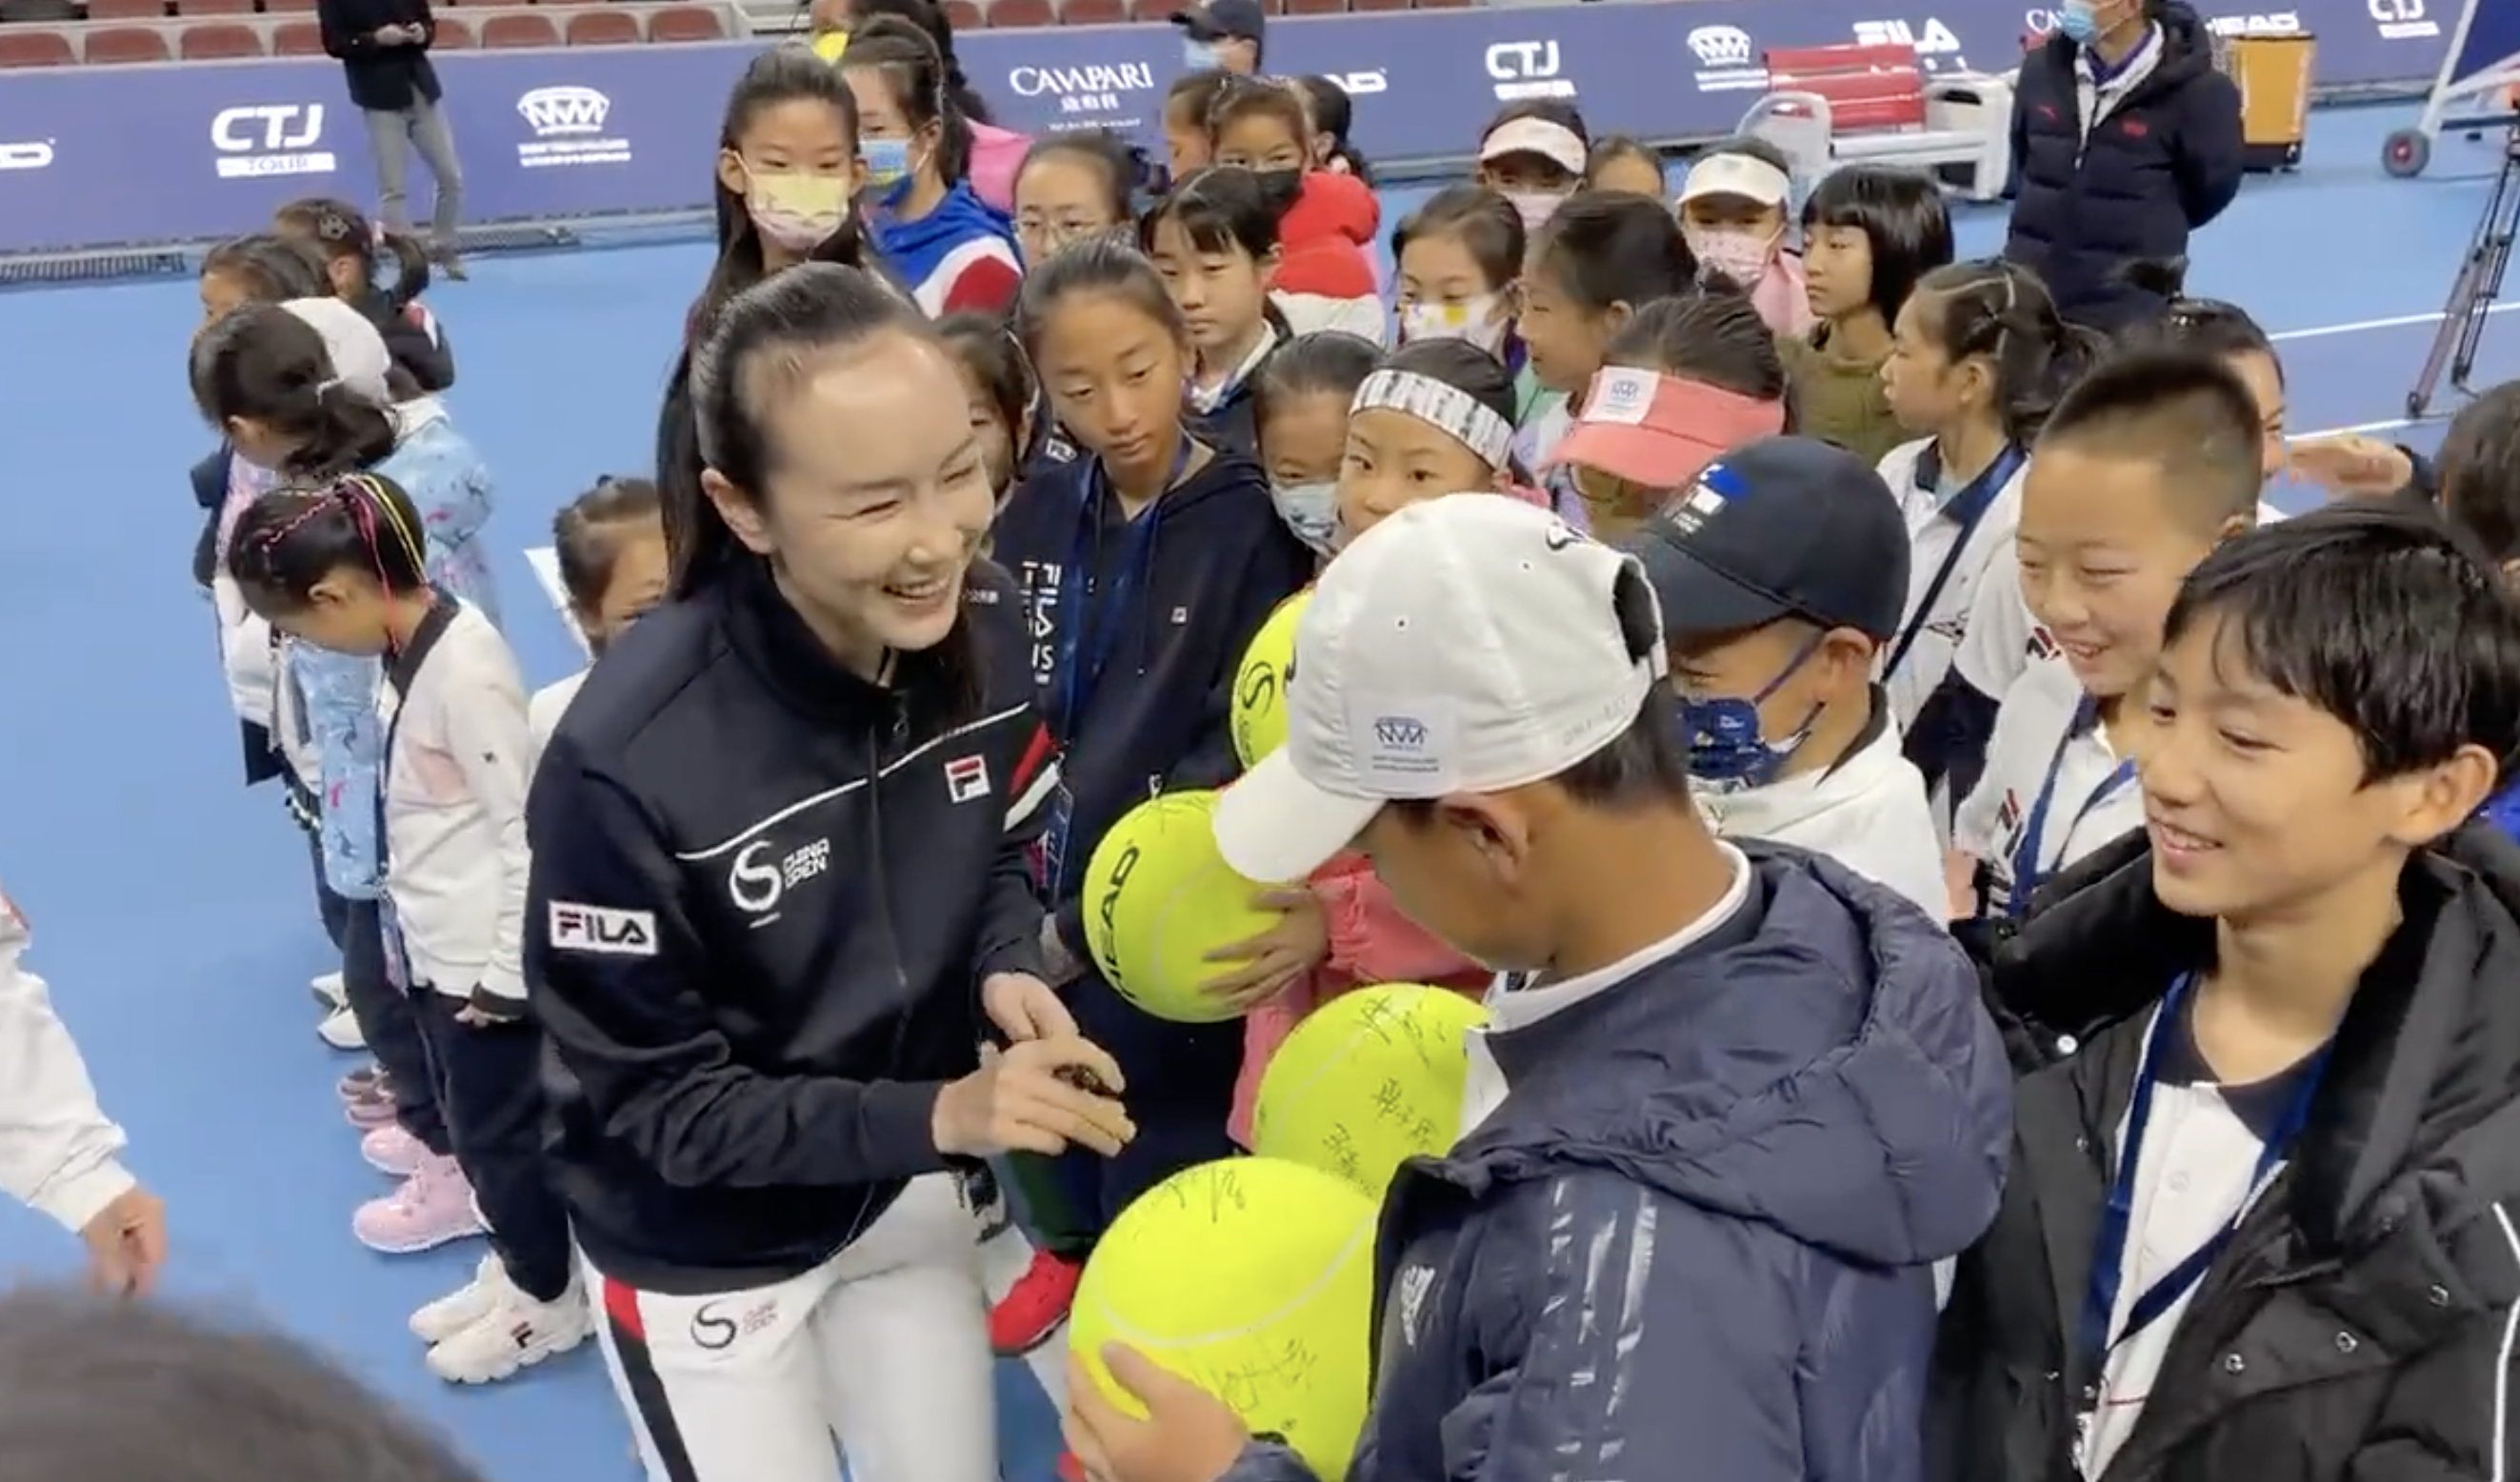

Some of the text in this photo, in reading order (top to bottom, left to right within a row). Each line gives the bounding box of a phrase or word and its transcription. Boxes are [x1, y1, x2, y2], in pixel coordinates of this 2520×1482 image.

[1486, 40, 1559, 79] CTJ
[1010, 62, 1154, 95] CAMPARI
[211, 104, 324, 151] CTJ
[557, 910, 649, 945] FILA
